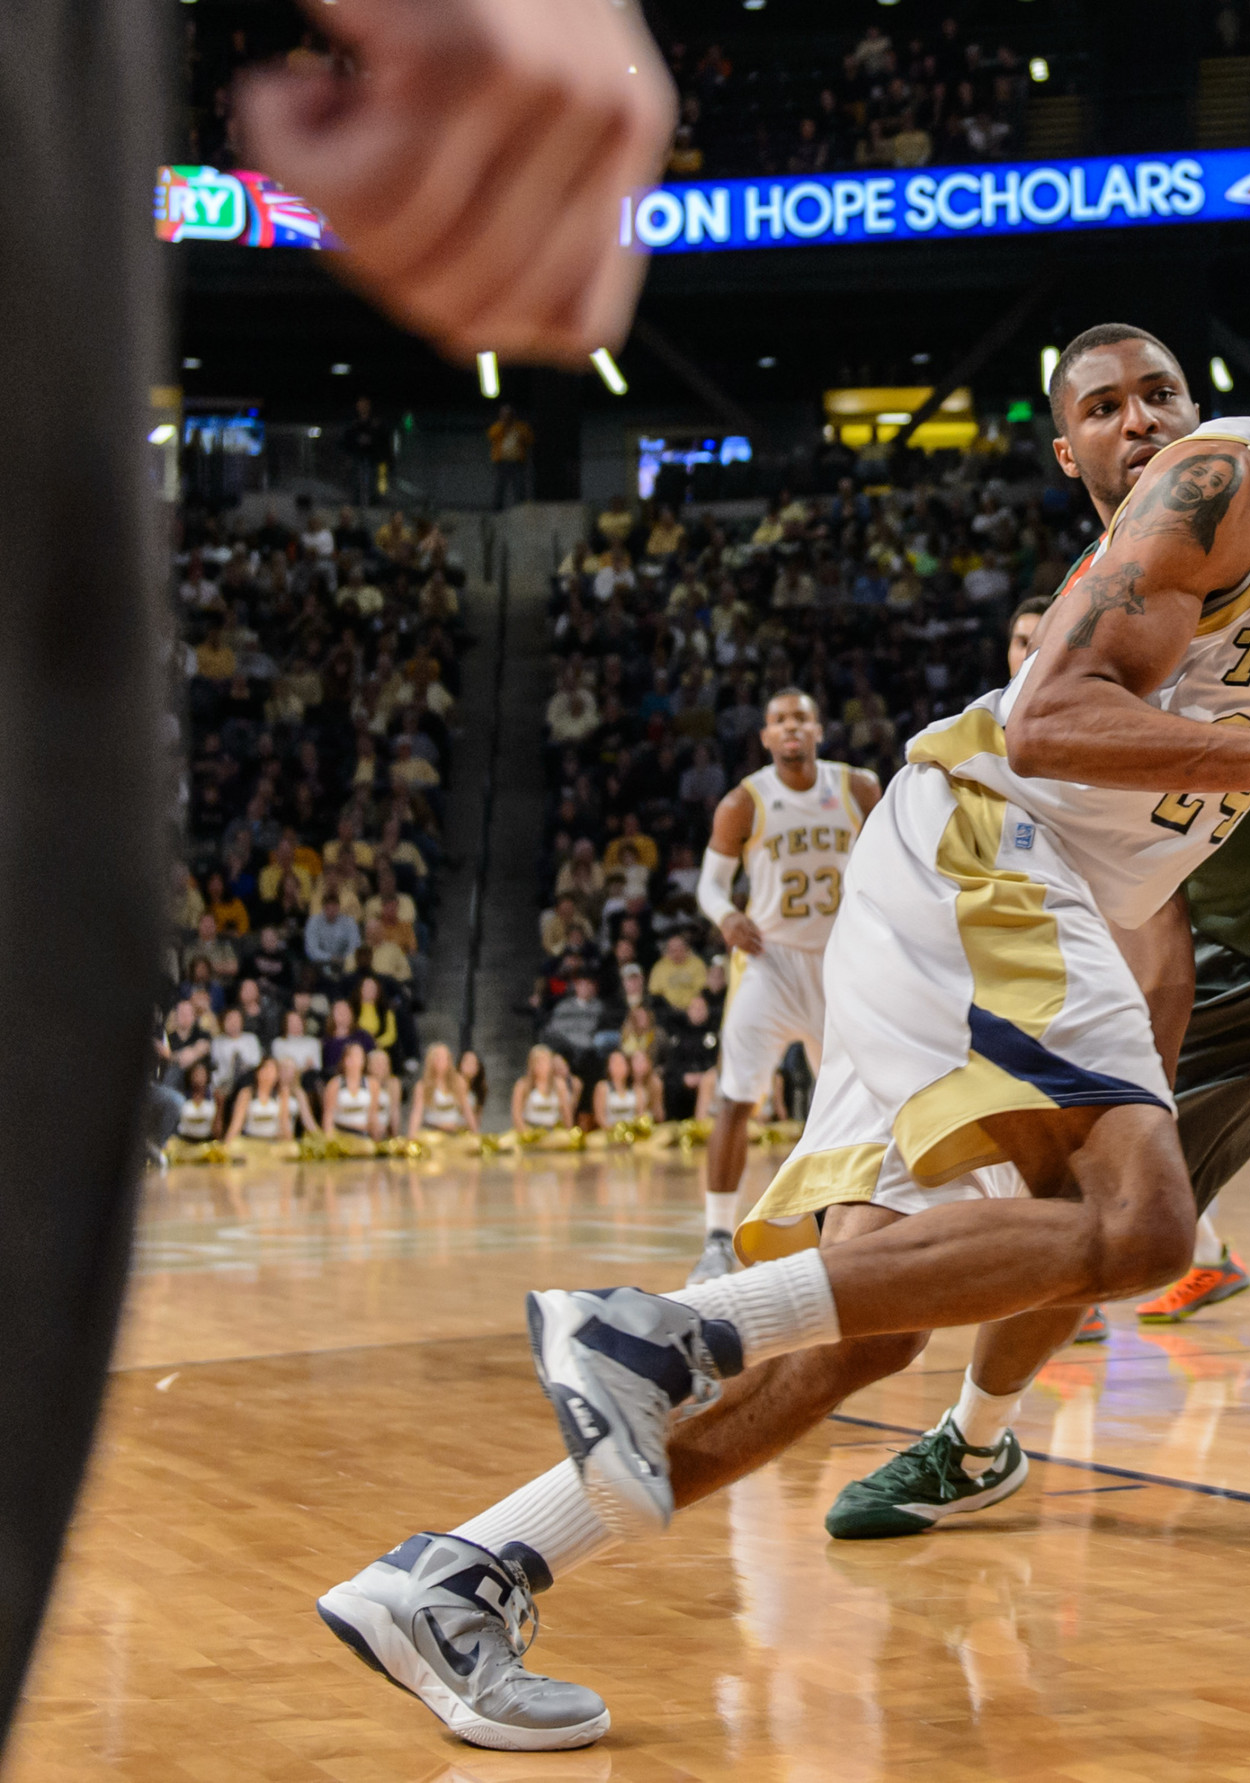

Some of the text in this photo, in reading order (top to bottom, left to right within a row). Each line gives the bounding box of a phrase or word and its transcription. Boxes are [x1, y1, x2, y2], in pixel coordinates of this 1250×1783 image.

[745, 177, 896, 241] HOPE
[904, 158, 1206, 232] SCHOLARS
[763, 826, 851, 863] TECH
[782, 865, 841, 918] 23
